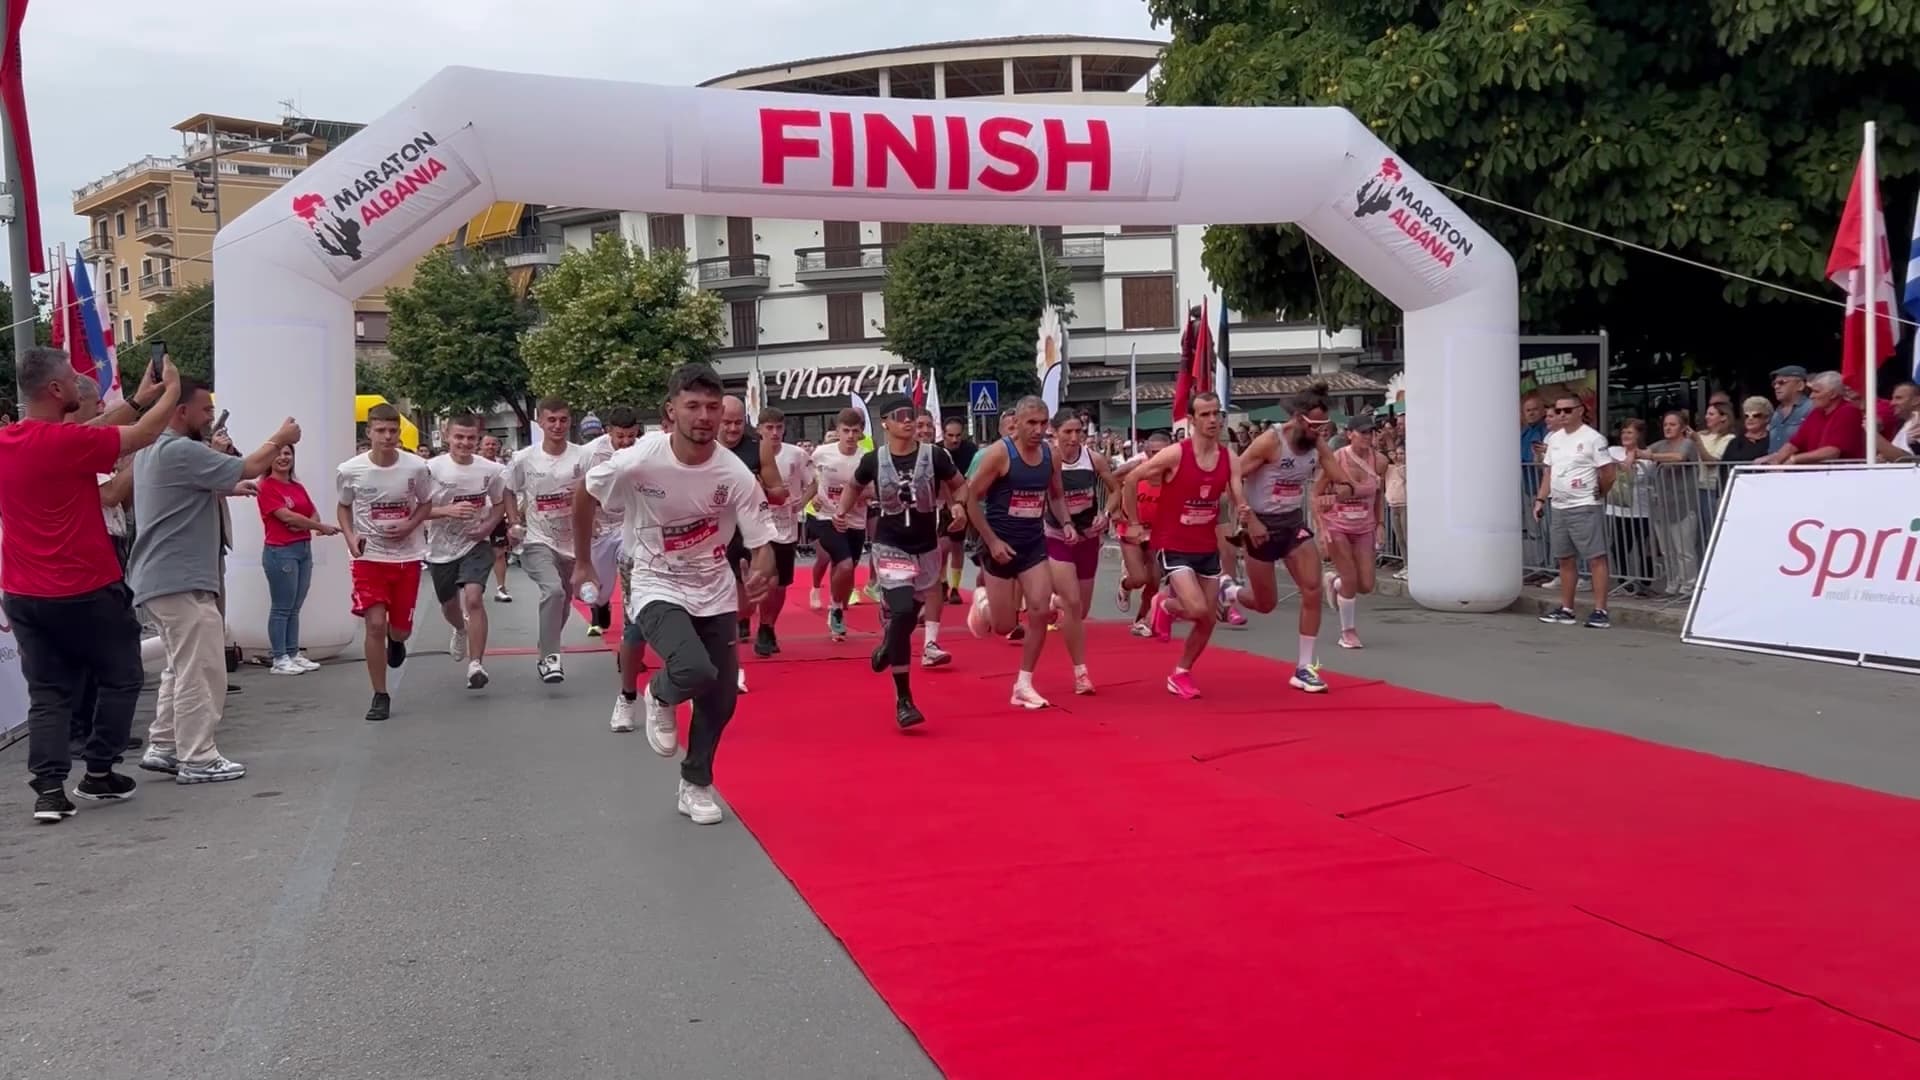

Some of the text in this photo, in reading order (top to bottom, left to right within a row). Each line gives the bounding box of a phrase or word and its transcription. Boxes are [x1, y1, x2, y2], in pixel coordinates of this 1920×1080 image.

[333, 131, 438, 212] MARATON
[759, 108, 1112, 192] FINISH
[360, 157, 447, 227] ALBANIA
[1396, 186, 1473, 256] MARATON
[1388, 208, 1455, 268] ALBANIA
[1779, 518, 1920, 597] Spri
